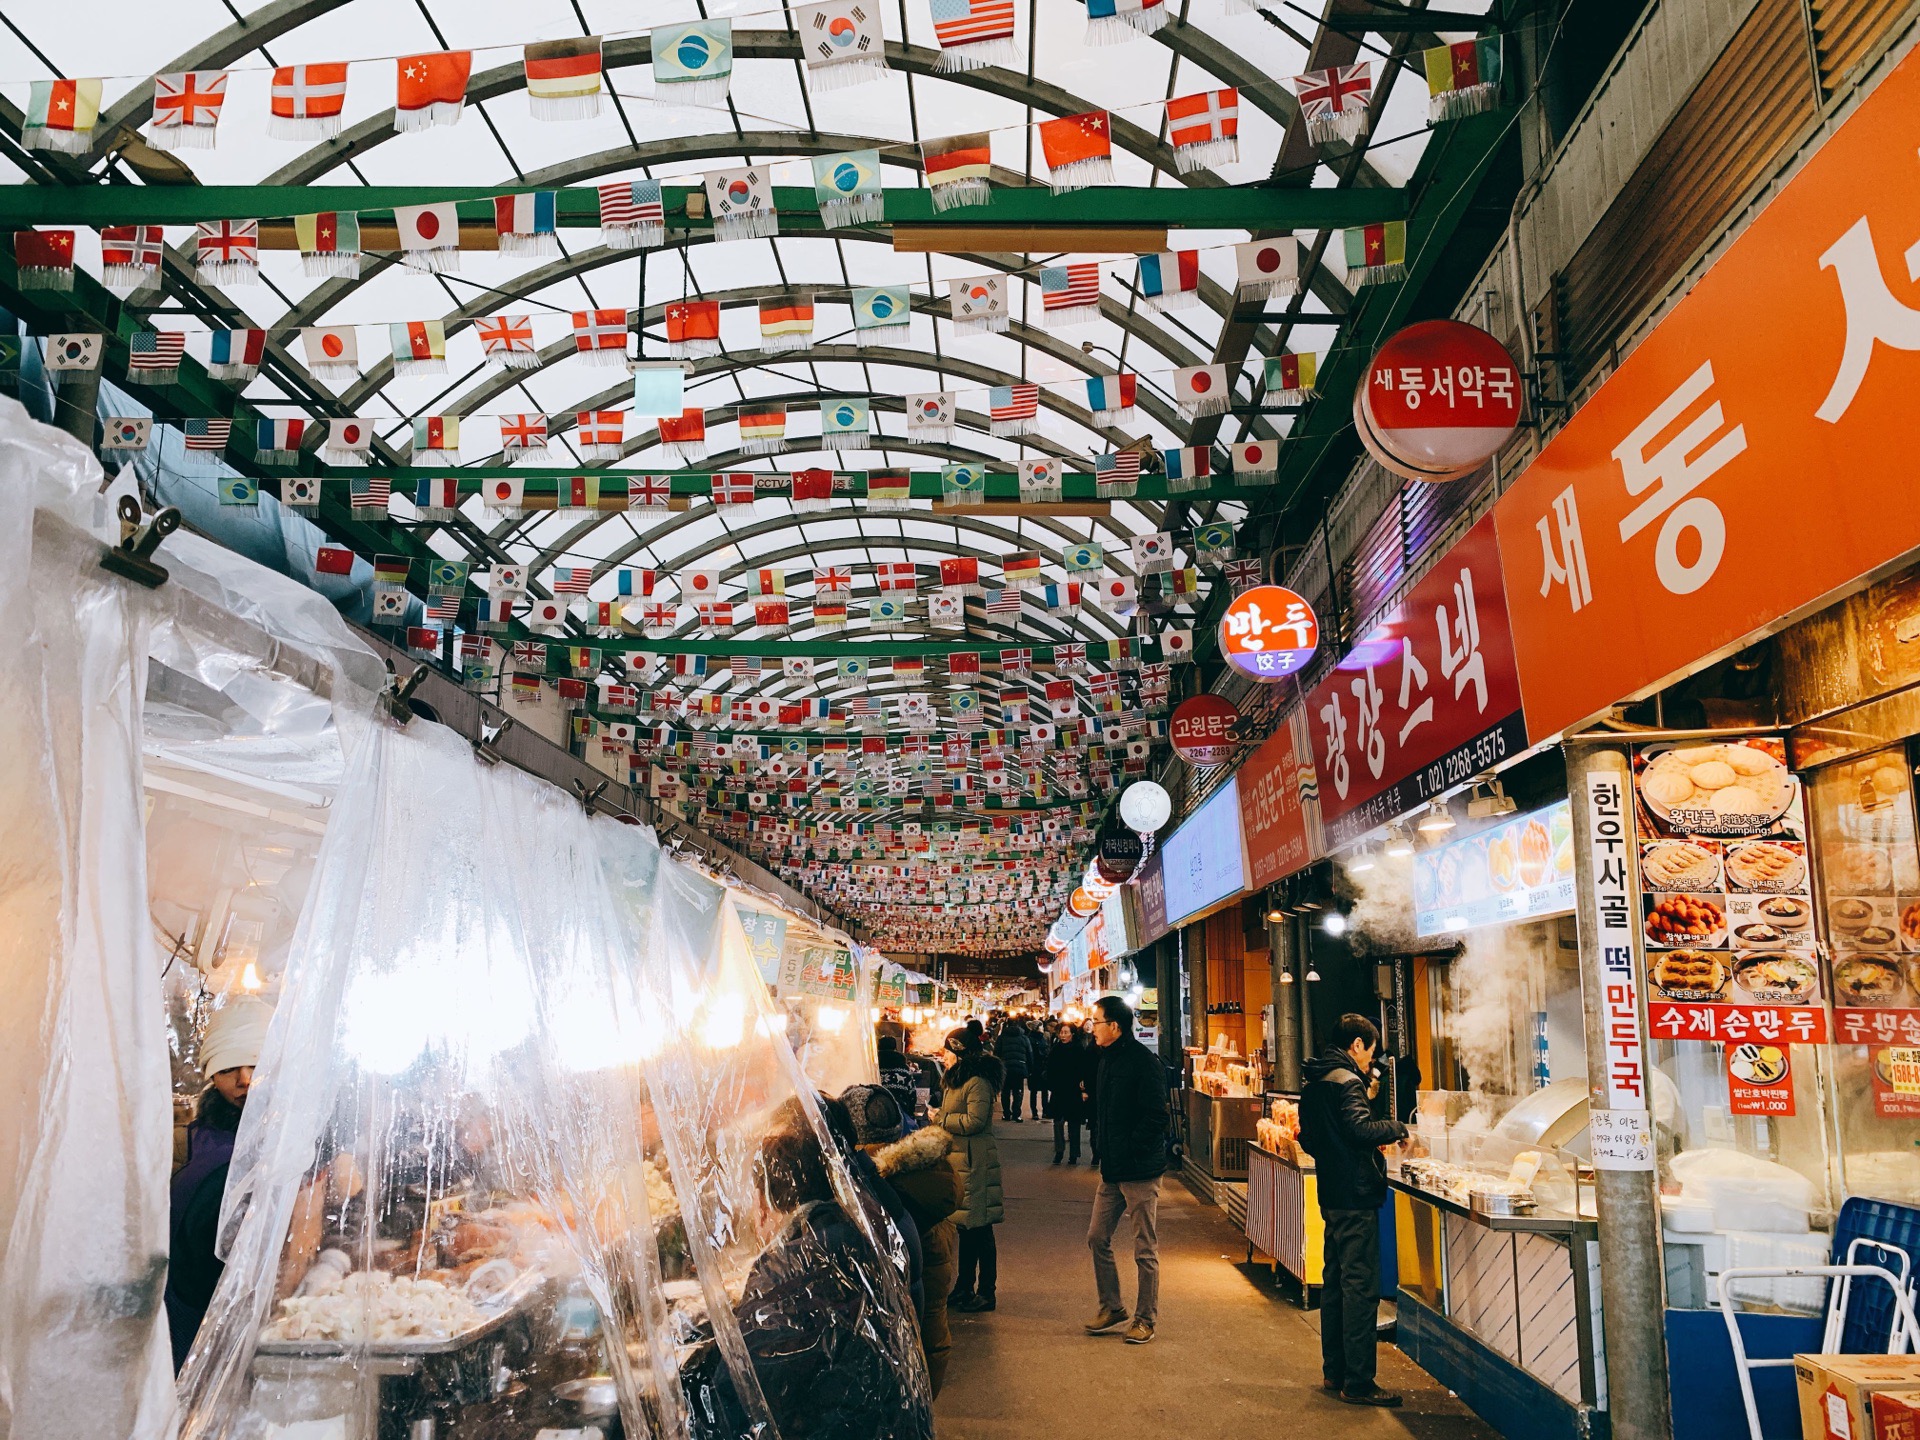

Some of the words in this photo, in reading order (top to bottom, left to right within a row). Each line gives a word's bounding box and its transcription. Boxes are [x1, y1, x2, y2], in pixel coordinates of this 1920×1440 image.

[757, 480, 784, 488] CCTV
[1225, 602, 1314, 652] 만두
[1256, 652, 1296, 671] 饺子
[1320, 567, 1488, 800] 광장스넥
[1189, 747, 1231, 758] 2267-2289
[1428, 762, 1445, 791] 02)
[1446, 727, 1506, 784] 2268-5575
[1252, 764, 1286, 835] 고원문구
[1360, 795, 1385, 830] 수제만두
[1669, 809, 1717, 825] 왕만두
[1721, 825, 1773, 836] Dumplings
[1592, 783, 1630, 929] 한우사골
[1657, 990, 1702, 999] 수제손만두
[1753, 991, 1782, 1000] 만두국
[1656, 1006, 1817, 1041] 수제손만두
[1892, 1064, 1920, 1085] 1588-8
[1733, 1088, 1790, 1100] 쌀단호박찐빵
